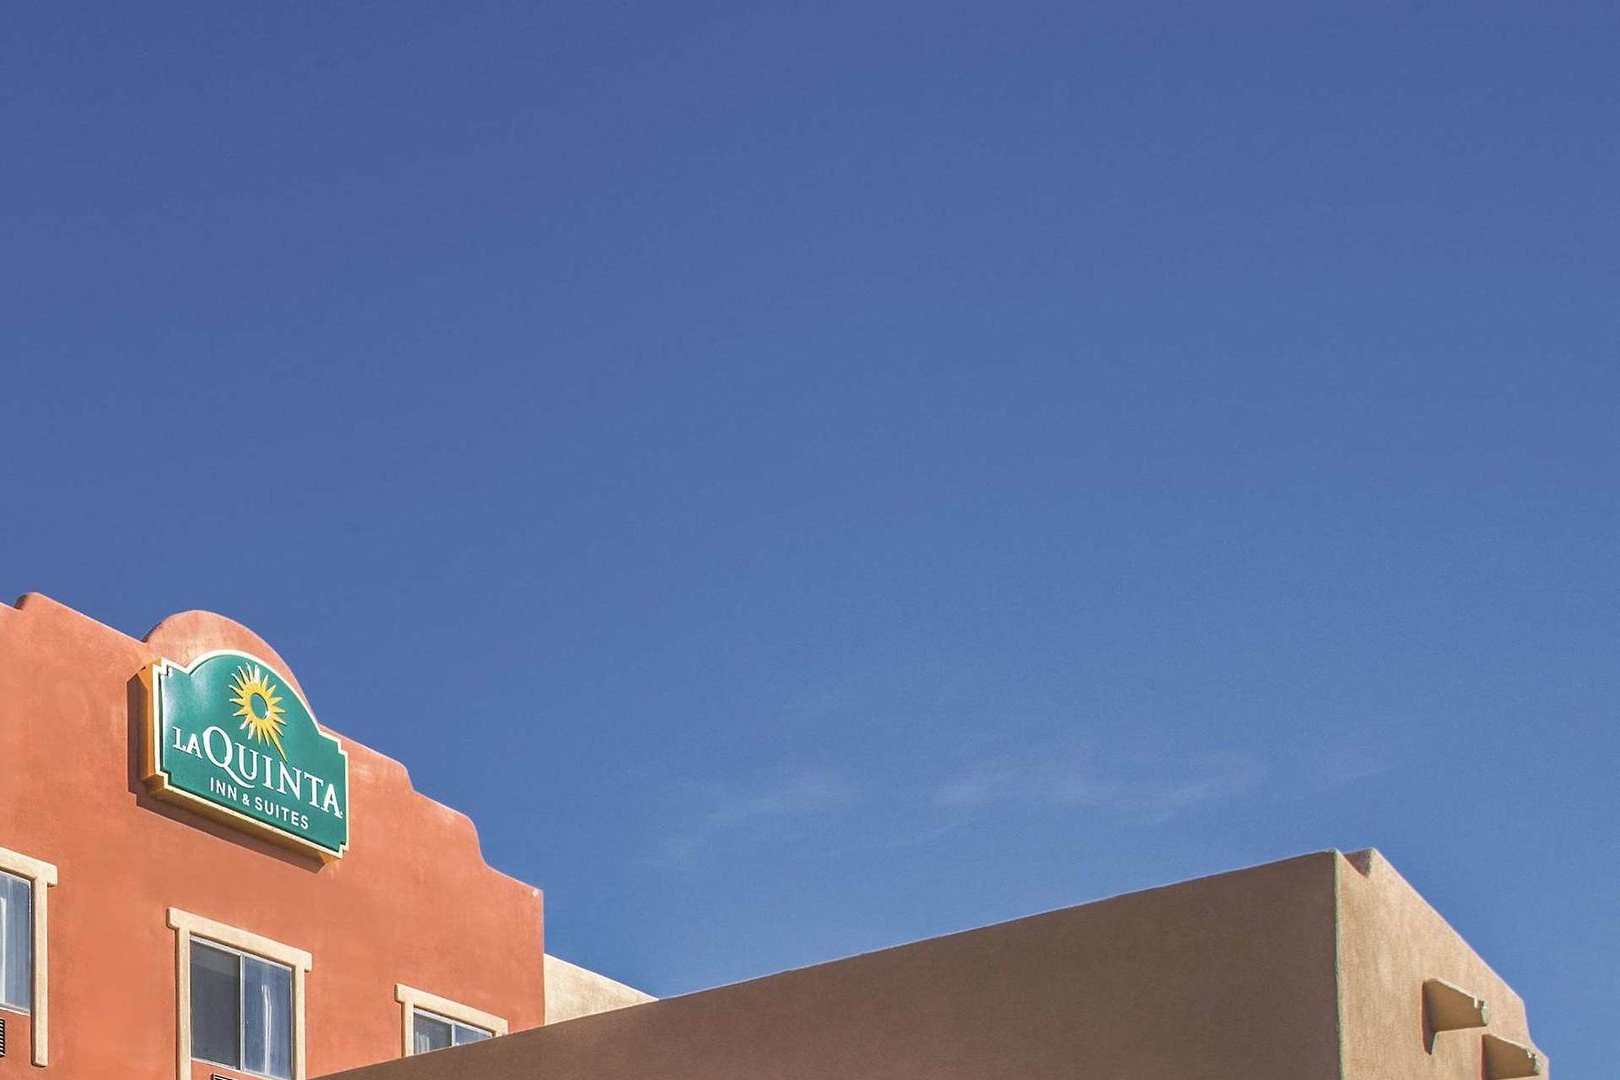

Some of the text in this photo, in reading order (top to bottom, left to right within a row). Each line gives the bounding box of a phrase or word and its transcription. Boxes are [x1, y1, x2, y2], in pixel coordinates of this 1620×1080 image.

[202, 725, 342, 818] QUINTA
[210, 777, 309, 829] INN & SUITES
